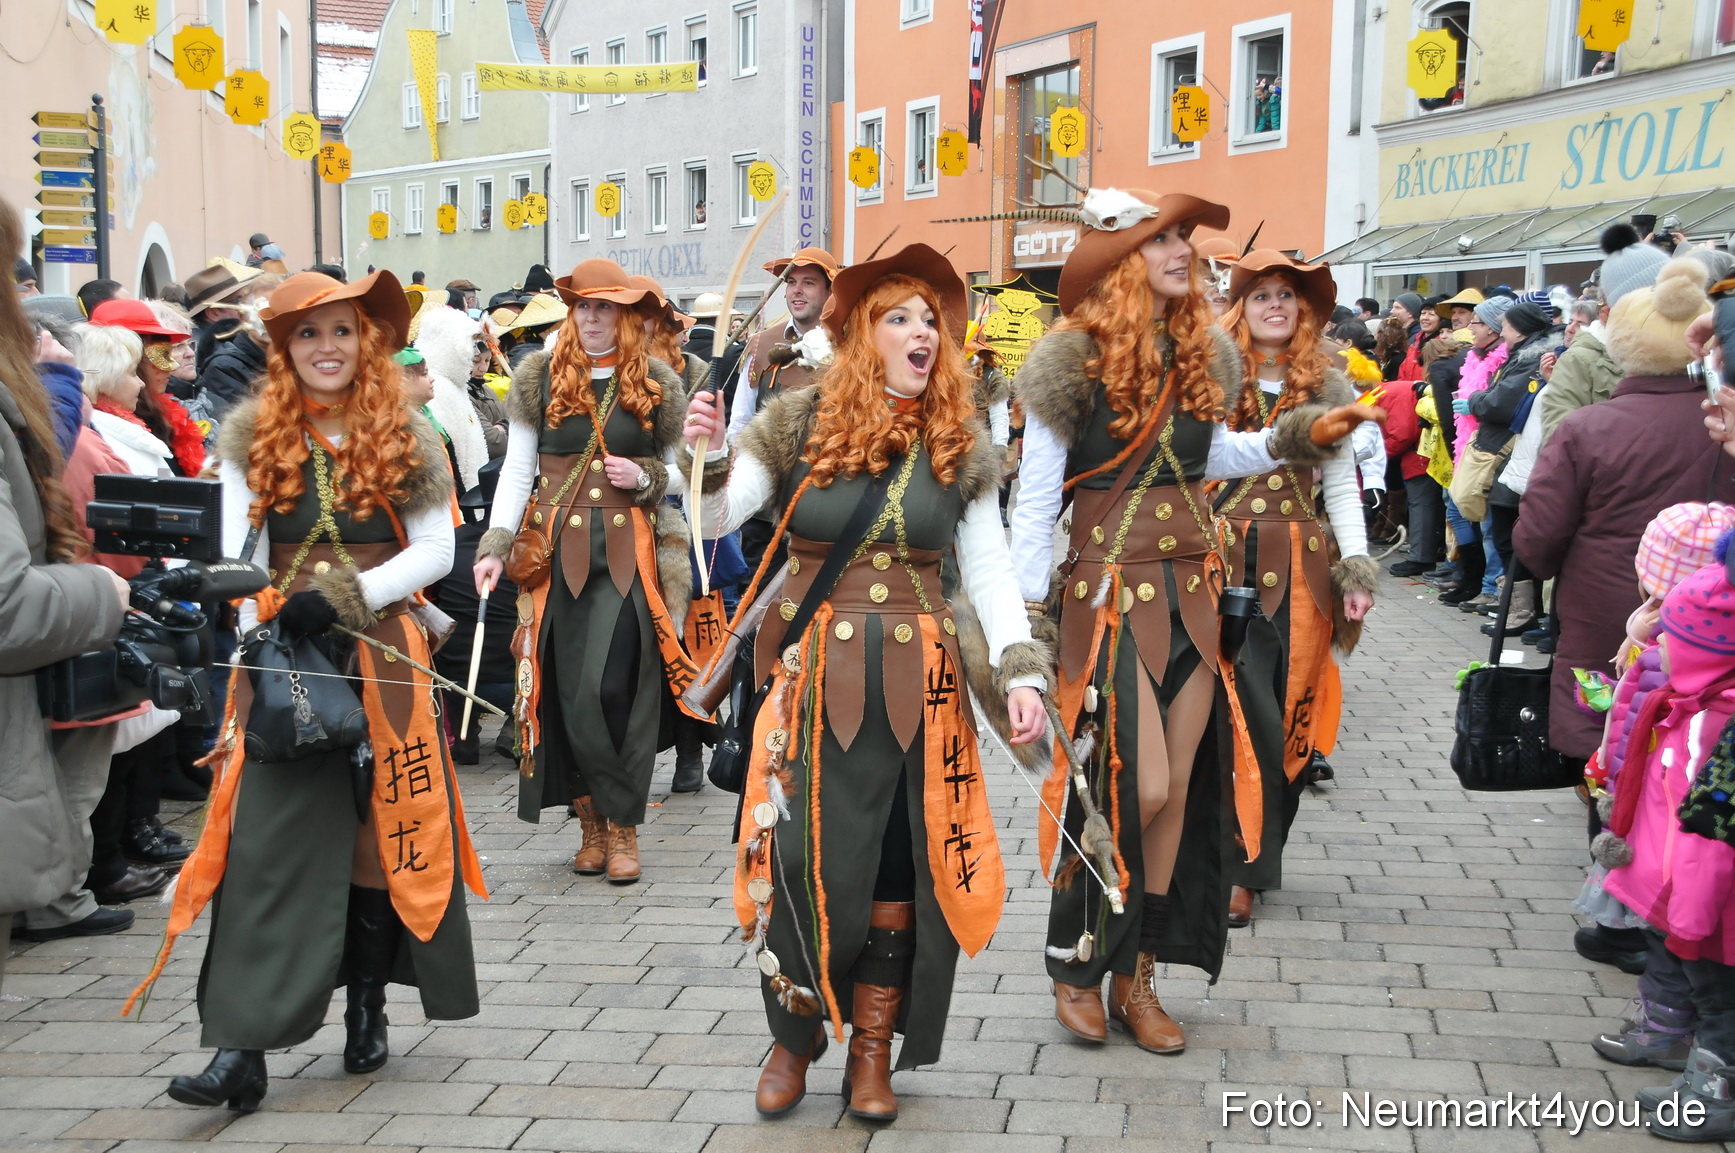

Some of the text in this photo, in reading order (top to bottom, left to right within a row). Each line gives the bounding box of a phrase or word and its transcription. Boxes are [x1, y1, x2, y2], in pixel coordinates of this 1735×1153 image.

[134, 5, 150, 23] 华
[1613, 9, 1625, 27] 华
[106, 18, 119, 33] 人
[1583, 25, 1595, 39] 人
[253, 96, 265, 108] 华
[231, 107, 241, 117] 人
[1193, 107, 1208, 127] 华
[1177, 117, 1189, 134] 人
[800, 26, 814, 249] UHREN SCHMUCK
[1393, 100, 1725, 200] BÄCKEREI STOLL
[323, 164, 333, 177] 人
[338, 158, 350, 172] 华
[1013, 229, 1076, 257] GÖTZ
[657, 241, 708, 278] OEXL
[1002, 366, 1016, 378] 34
[168, 679, 185, 688] SONY
